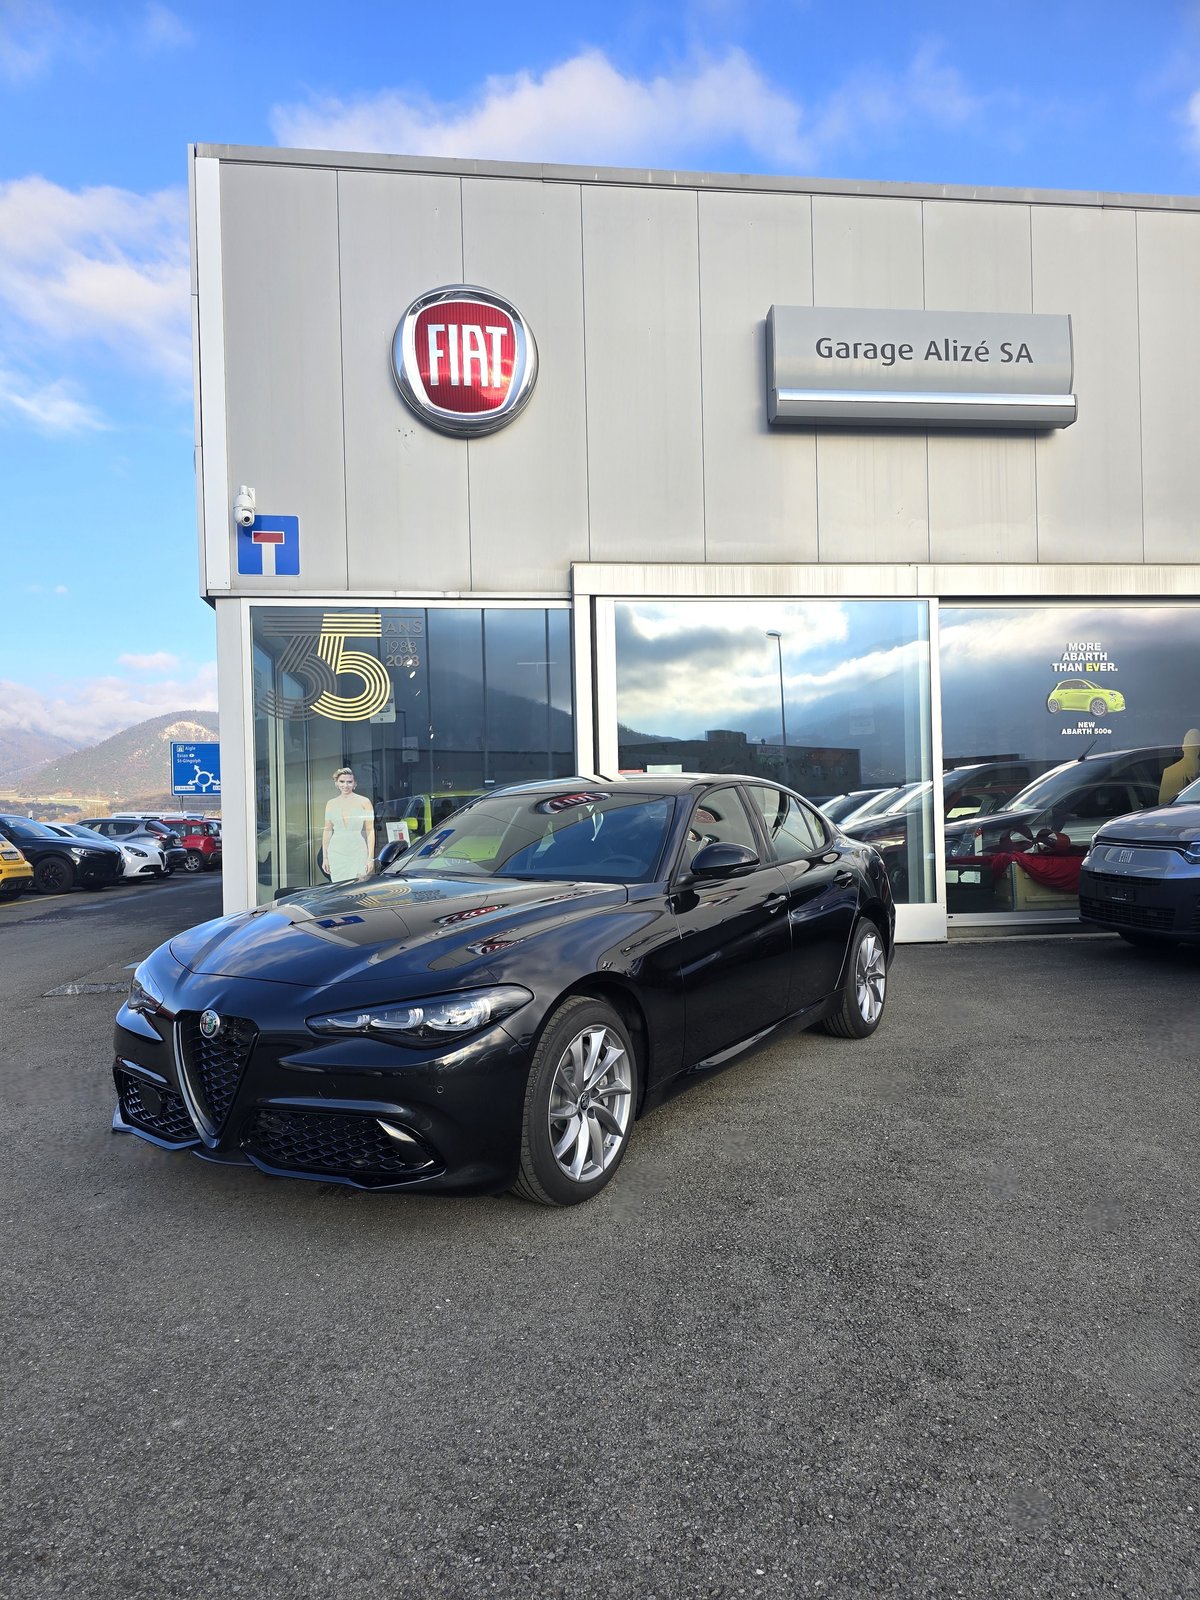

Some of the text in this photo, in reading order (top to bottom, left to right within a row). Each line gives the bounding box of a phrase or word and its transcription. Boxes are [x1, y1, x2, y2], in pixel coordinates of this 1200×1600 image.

[427, 323, 508, 388] FIAT
[815, 337, 1034, 366] Garage Alizé SA
[384, 621, 422, 634] ANS
[386, 640, 417, 654] 1988
[1067, 643, 1101, 651] MORE
[1062, 652, 1108, 661] ABARTH
[257, 613, 391, 721] 35
[1052, 663, 1118, 672] THAN EVER.
